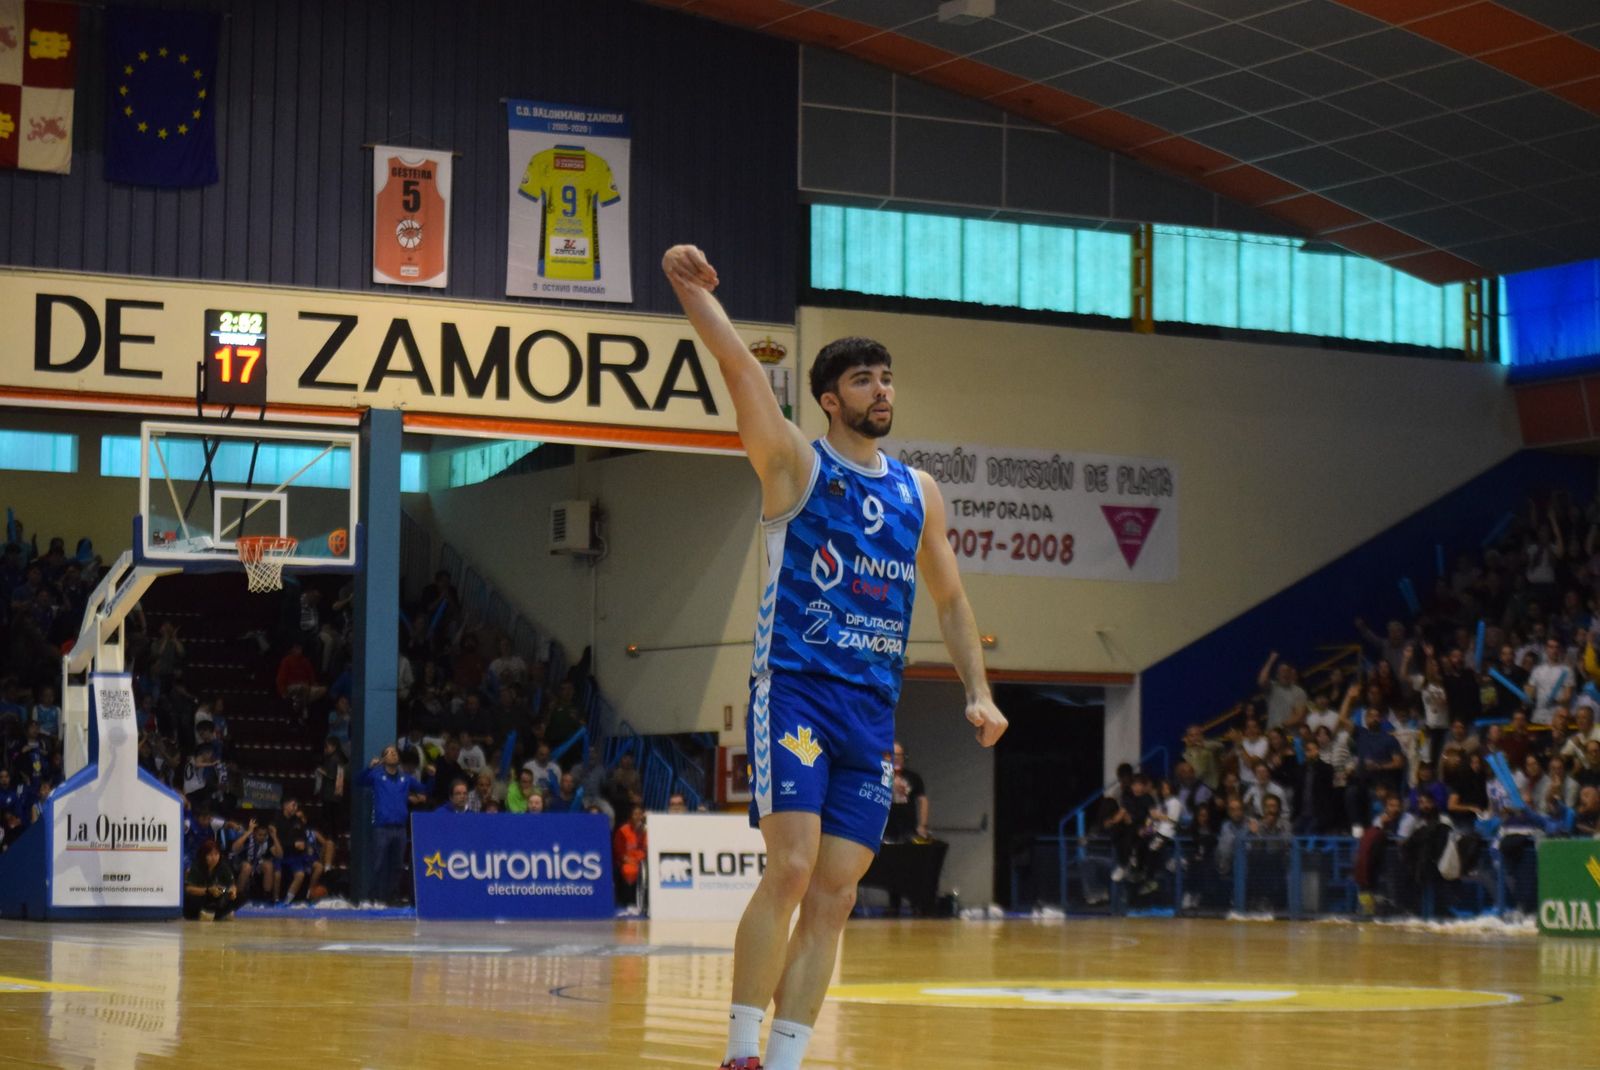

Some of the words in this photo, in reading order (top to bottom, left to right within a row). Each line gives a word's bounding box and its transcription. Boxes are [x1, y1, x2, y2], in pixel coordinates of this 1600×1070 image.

[532, 107, 586, 121] BALONMANO
[587, 112, 624, 124] ZAMORA
[402, 180, 421, 213] 5
[562, 185, 577, 217] 9
[532, 282, 538, 291] 9
[34, 293, 164, 379] DE
[298, 311, 719, 416] ZAMORA
[214, 346, 262, 384] 17
[986, 454, 1075, 491] DIVISIÓN
[1082, 464, 1110, 493] DE
[1116, 466, 1174, 497] PLATA
[862, 495, 885, 535] 9
[952, 499, 1054, 522] TEMPORADA
[947, 528, 1075, 565] 007-2008
[853, 555, 915, 583] INNOVA
[837, 630, 903, 655] ZAMORA
[858, 788, 872, 800] DE
[66, 814, 89, 842] La
[95, 814, 168, 850] Opinión
[447, 844, 603, 880] euronics
[487, 883, 594, 896] electrodomésticos
